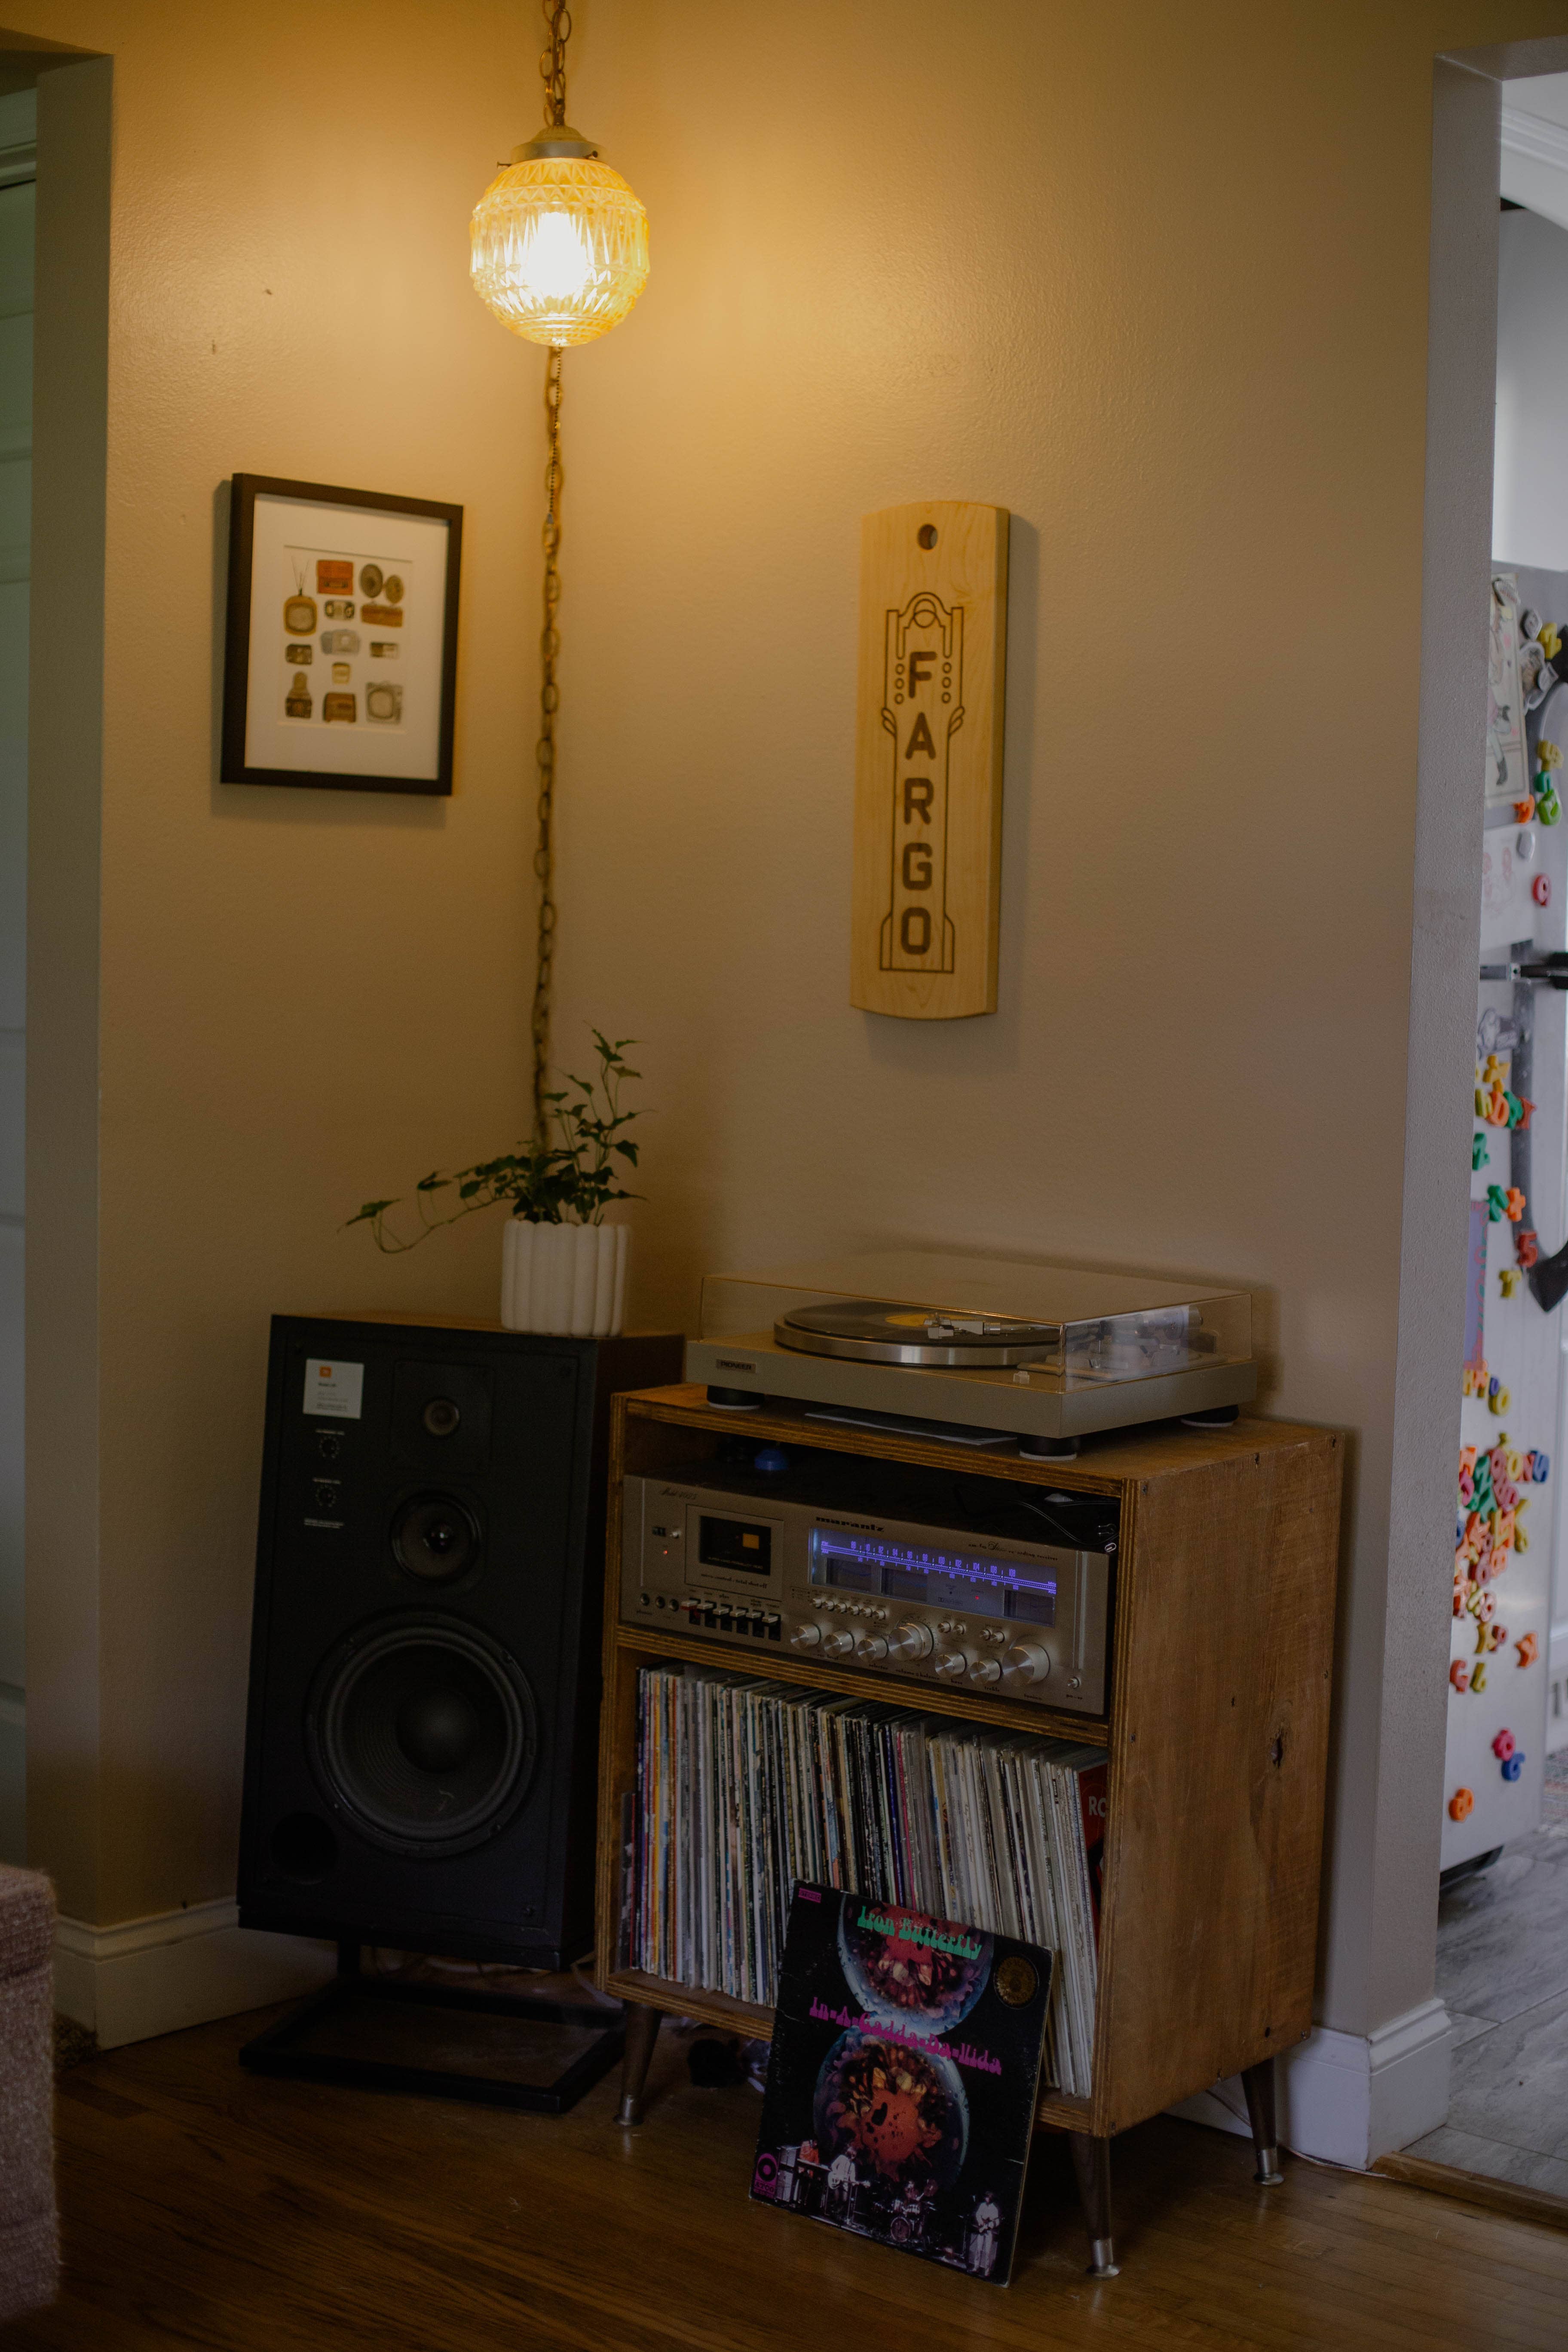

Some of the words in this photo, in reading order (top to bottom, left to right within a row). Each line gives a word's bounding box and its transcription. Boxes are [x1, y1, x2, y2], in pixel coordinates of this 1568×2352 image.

[900, 651, 937, 956] FARGO
[721, 1360, 752, 1370] PIONEER
[856, 1905, 895, 1936] Iron
[898, 1917, 983, 1960] Butterfly
